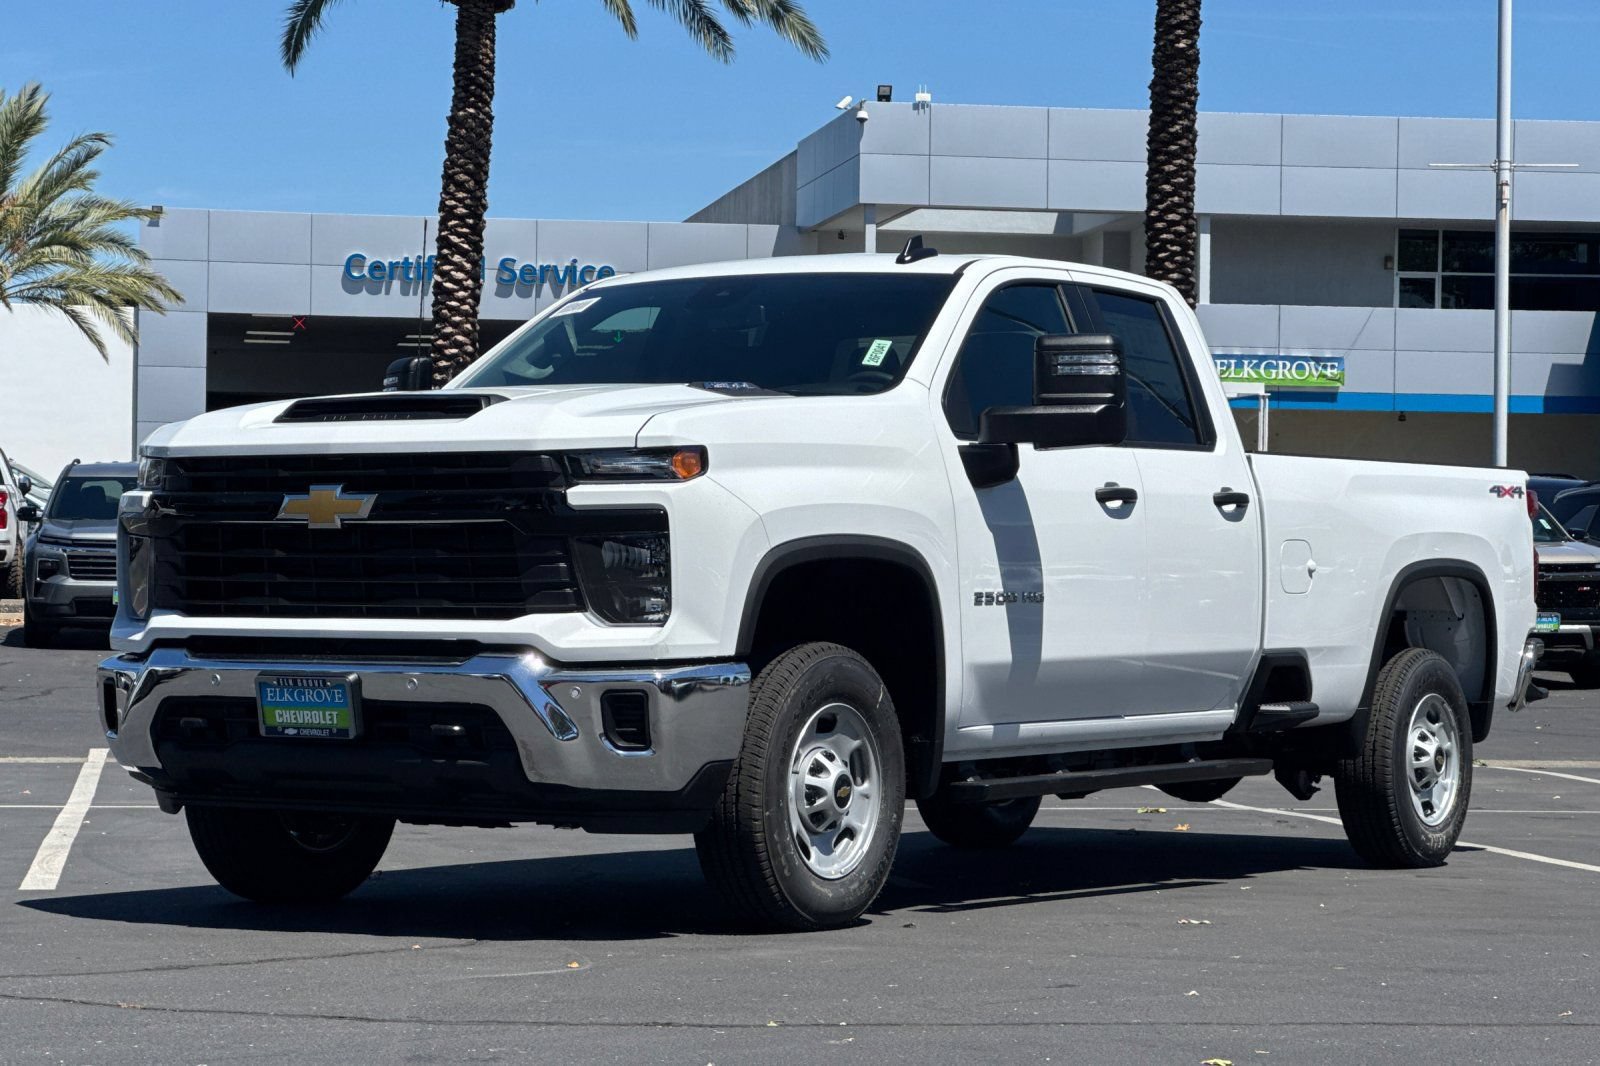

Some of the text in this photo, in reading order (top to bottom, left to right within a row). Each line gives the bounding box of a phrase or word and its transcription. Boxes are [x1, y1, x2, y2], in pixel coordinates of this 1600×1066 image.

[344, 253, 616, 286] Certif Service
[275, 709, 338, 725] CHEVROLET
[300, 728, 330, 737] CHEVROLET
